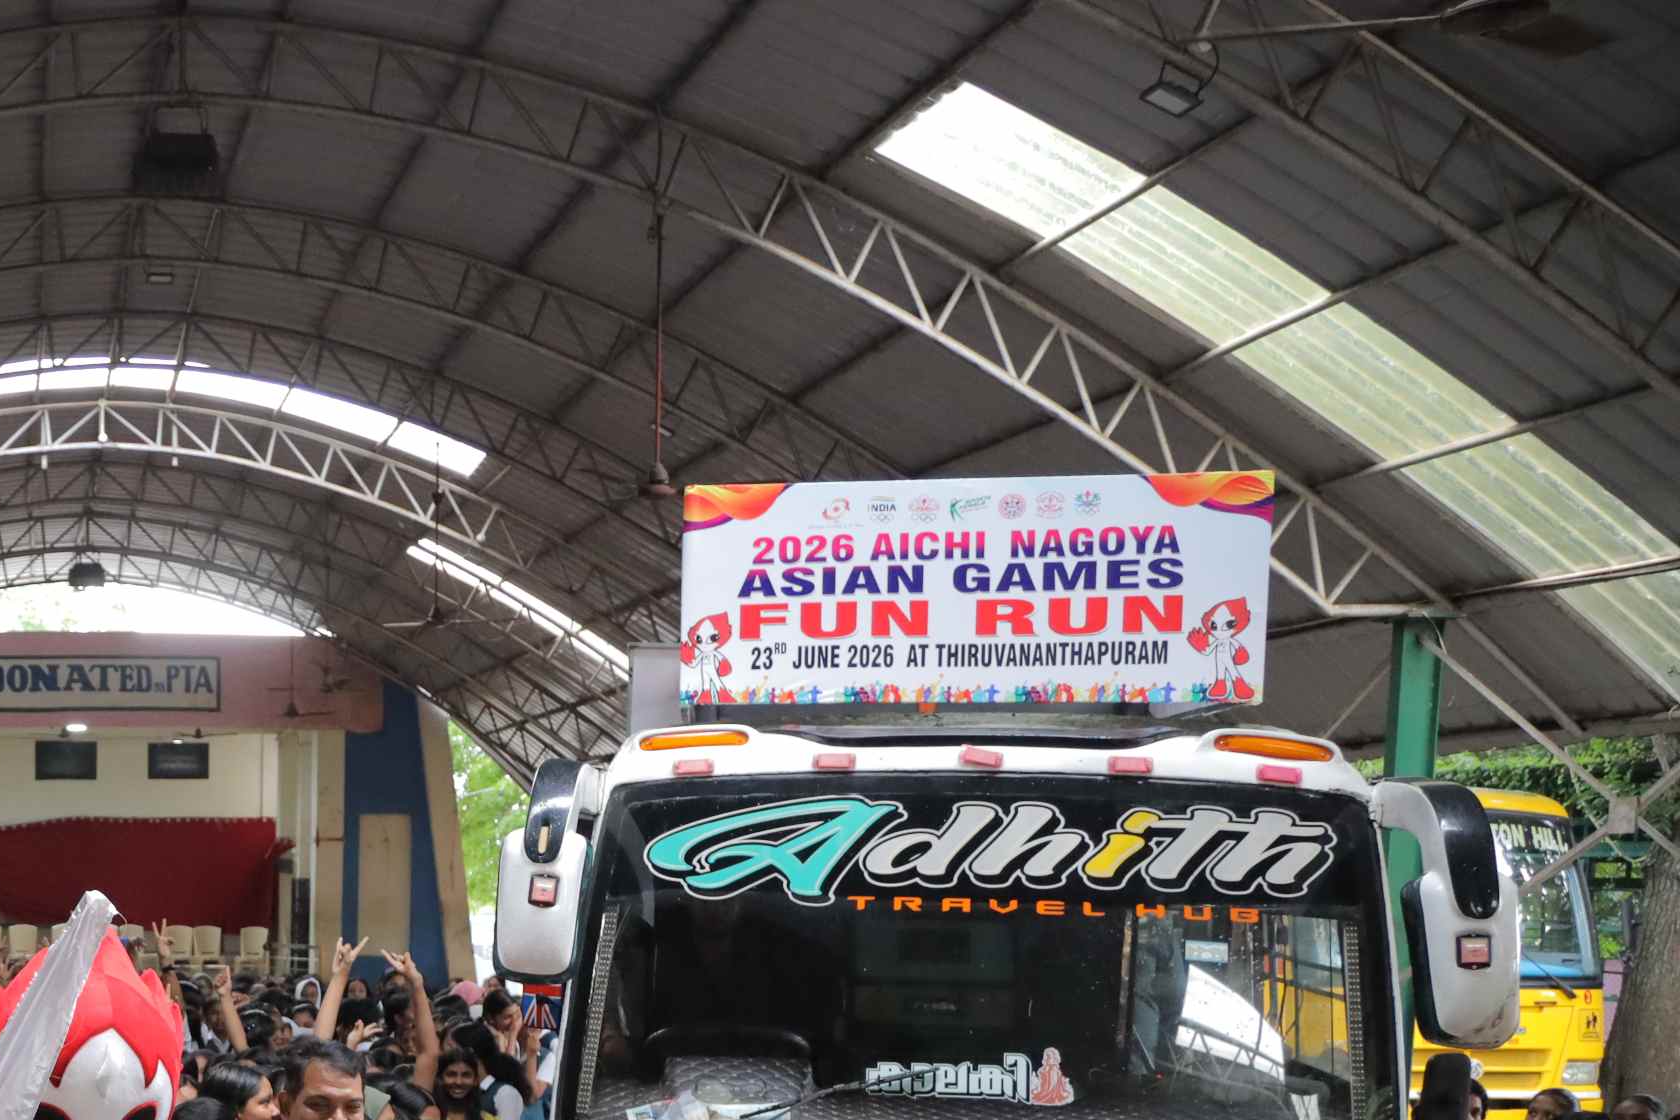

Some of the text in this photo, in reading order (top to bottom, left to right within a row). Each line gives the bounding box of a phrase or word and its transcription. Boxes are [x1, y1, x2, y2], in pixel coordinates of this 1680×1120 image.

[867, 503, 897, 512] INDIA
[752, 524, 1181, 564] 2026 AICHI NAGOYA
[738, 558, 1184, 597] ASIAN GAMES
[738, 595, 1186, 641] FUN RUN
[751, 640, 1169, 670] 23RD JUNE 2026 AT THIRUVANANTHAPURAM
[165, 665, 214, 694] PTA
[848, 894, 1260, 924] TRAVEL HUB
